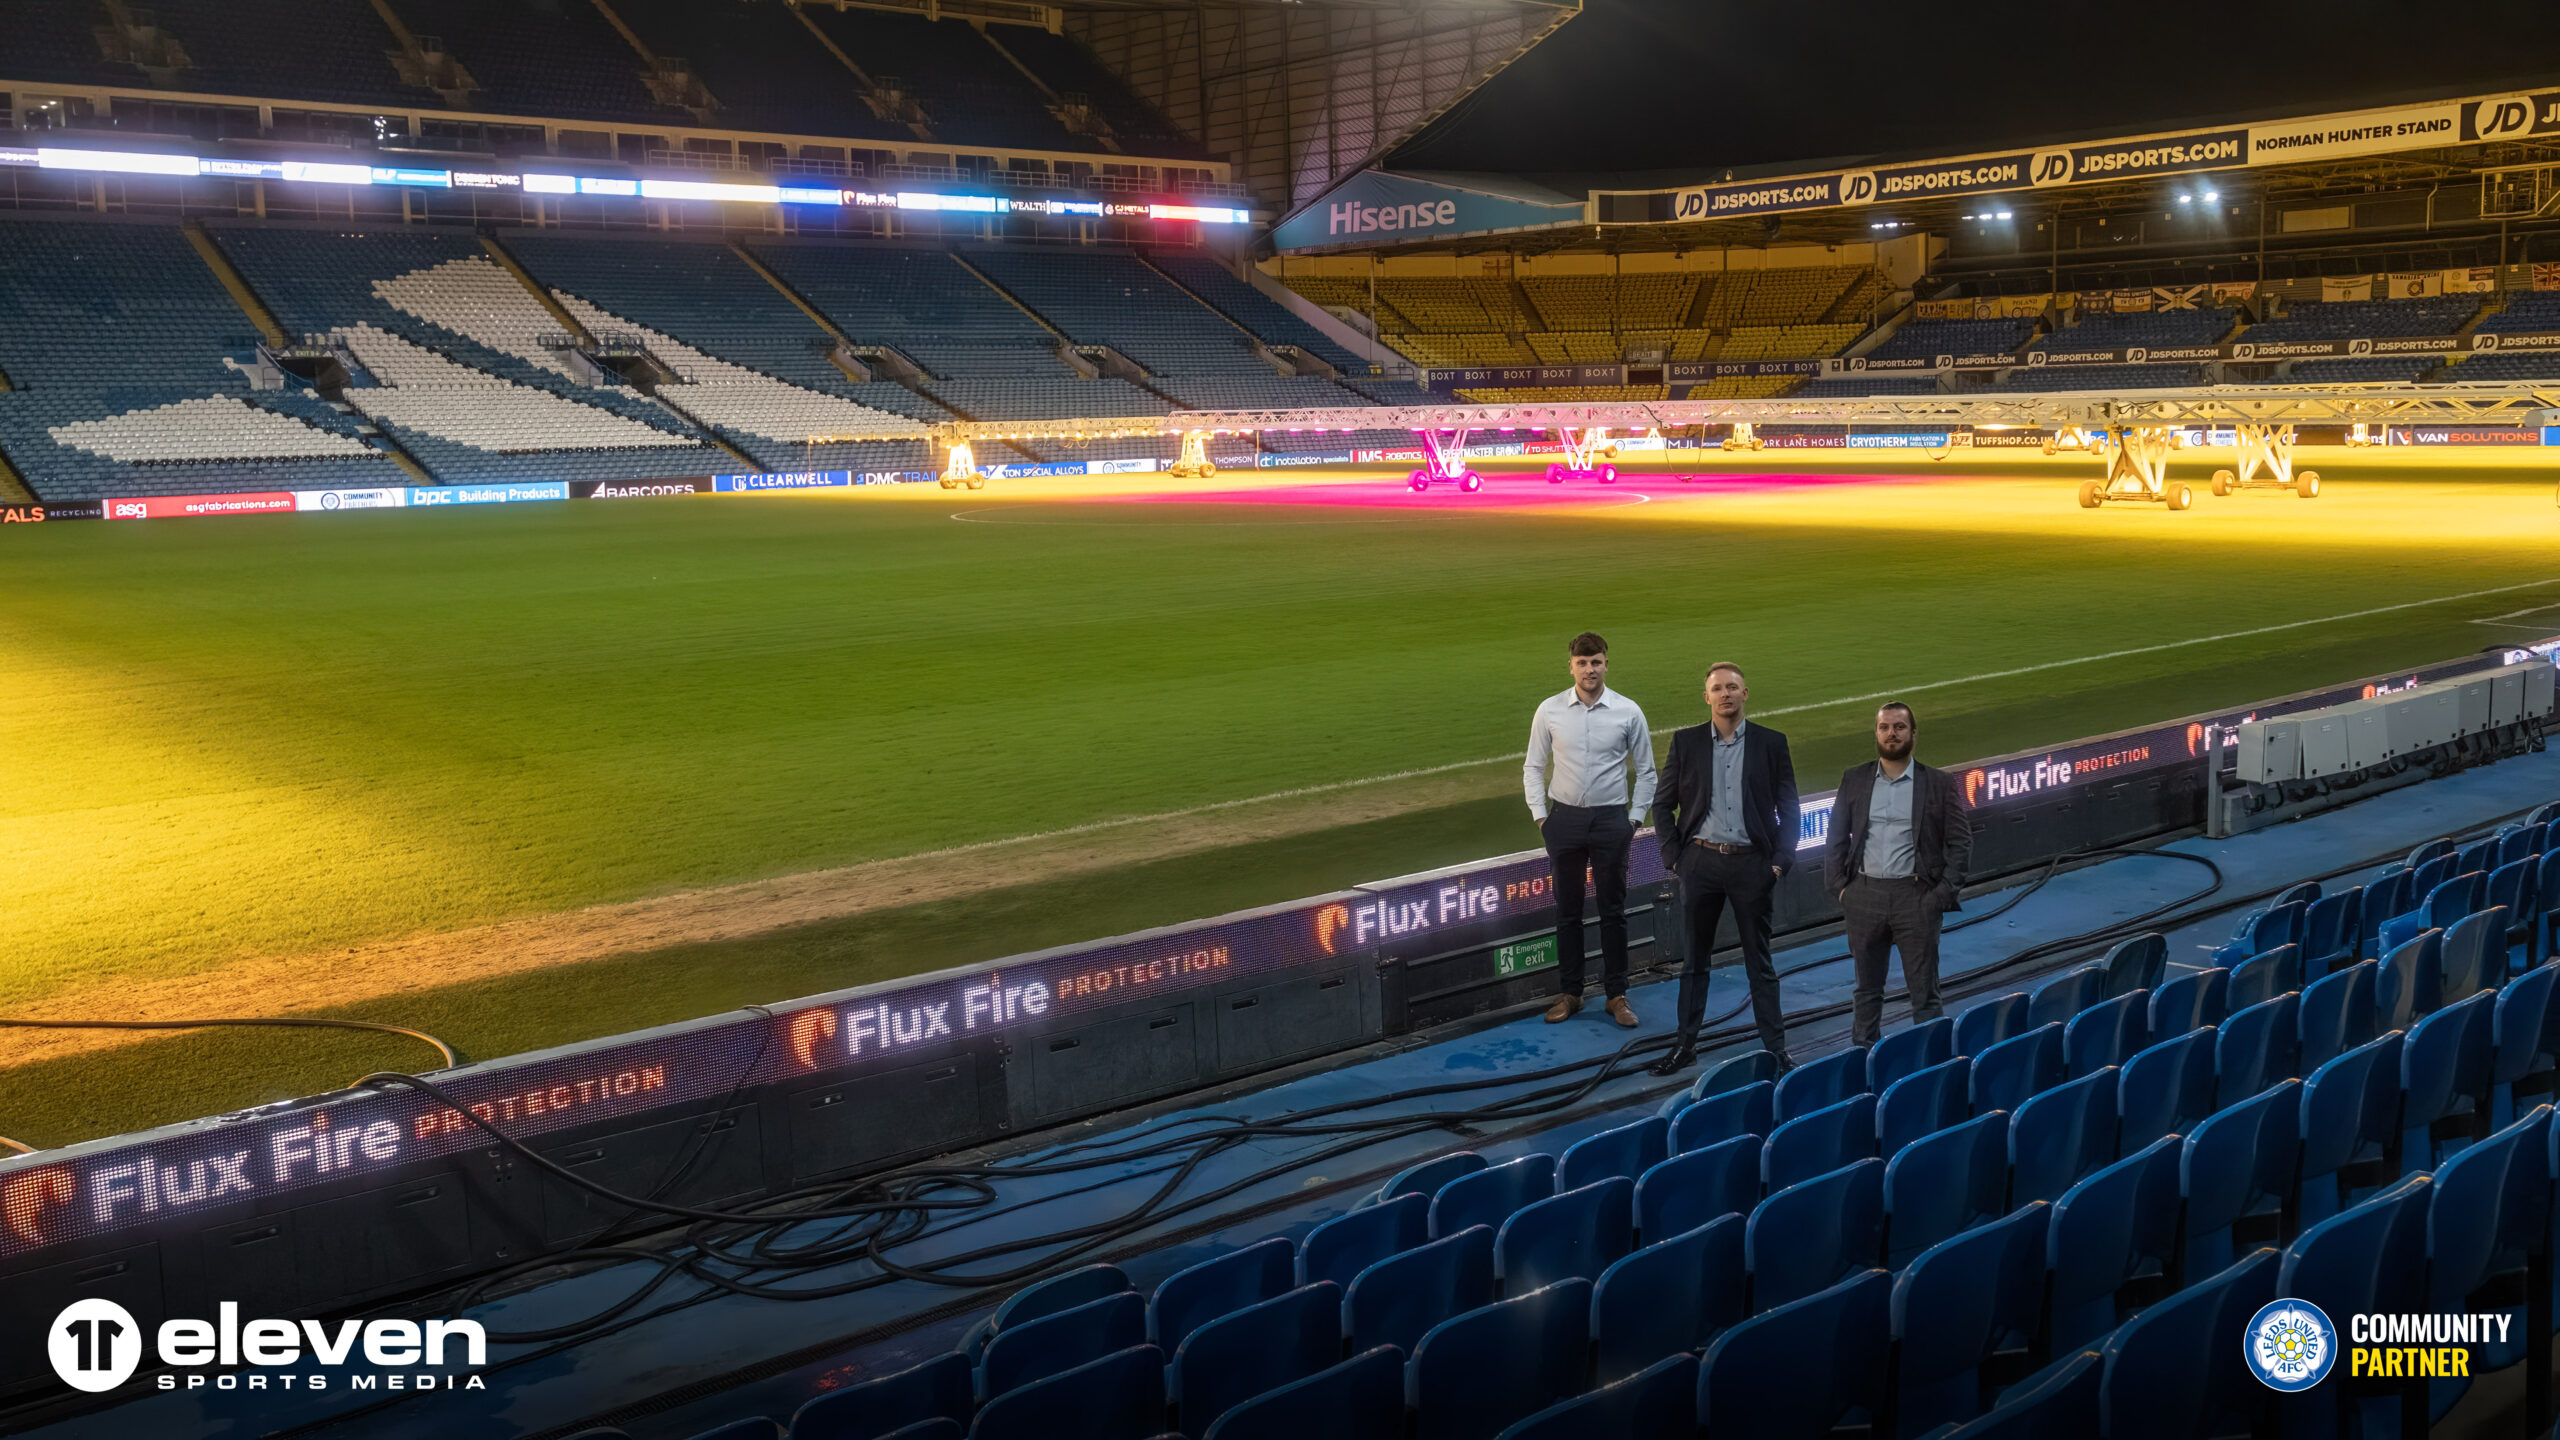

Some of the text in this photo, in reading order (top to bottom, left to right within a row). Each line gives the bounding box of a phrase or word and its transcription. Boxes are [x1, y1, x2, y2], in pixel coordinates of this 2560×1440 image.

[2483, 102, 2527, 135] JD
[2256, 118, 2452, 151] NORMAN HUNTER STAND
[2036, 140, 2238, 181] JD JDSPORTS.COM
[1849, 164, 2018, 201] JD JDSPORTS.COM
[1679, 184, 1829, 217] JD JDSPORTS.COM
[1010, 201, 1046, 211] WEALTH
[1329, 200, 1456, 235] Hisense
[2257, 345, 2333, 355] JDSPORTS.COM
[2375, 340, 2457, 351] JDSPORTS.COM
[2048, 352, 2113, 362] JDSPORTS.COM
[2148, 348, 2219, 358] JDSPORTS.COM
[1867, 358, 1925, 368] JDSPORTS.COM
[1954, 355, 2016, 366] JDSPORTS.COM
[1674, 366, 1705, 375] BOXT
[1716, 364, 1747, 374] BOXT
[1759, 363, 1788, 373] BOXT
[1794, 362, 1820, 372] BOXT
[1431, 372, 1456, 381] BOXT
[1465, 371, 1492, 380] BOXT
[1504, 370, 1532, 379] BOXT
[1543, 369, 1572, 378] BOXT
[1585, 368, 1615, 377] BOXT
[1850, 436, 1908, 448] CRYOTHERM
[1975, 436, 2054, 447] TUFFSHOP.CO.UK
[2417, 432, 2538, 442] VAN SOLUTIONS
[1668, 440, 1699, 449] MJL
[1763, 438, 1845, 447] ARK LANE HOMES
[1496, 446, 1521, 456] GROUP
[1215, 456, 1253, 465] THOMPSON
[1358, 450, 1422, 463] IMS ROBOTICS
[1023, 468, 1053, 476] SPECIAL
[1055, 466, 1084, 474] ALLOYS
[750, 472, 832, 487] CLEARWELL
[866, 472, 900, 485] DMC
[344, 492, 382, 500] COMMUNITY
[414, 487, 560, 505] bpc Building Products
[50, 509, 101, 517] RECYCLING
[116, 498, 290, 519] asg asgfabrications.com
[1987, 746, 2150, 801] Flux Fire PROTECTION
[1355, 895, 1429, 944] Flux
[1439, 880, 1499, 928] Fire
[1516, 940, 1553, 954] Emergency
[1525, 951, 1545, 966] exit
[847, 946, 1230, 1056] Flux Fire PROTECTION
[89, 1066, 664, 1225] Flux Fire PROTECTION
